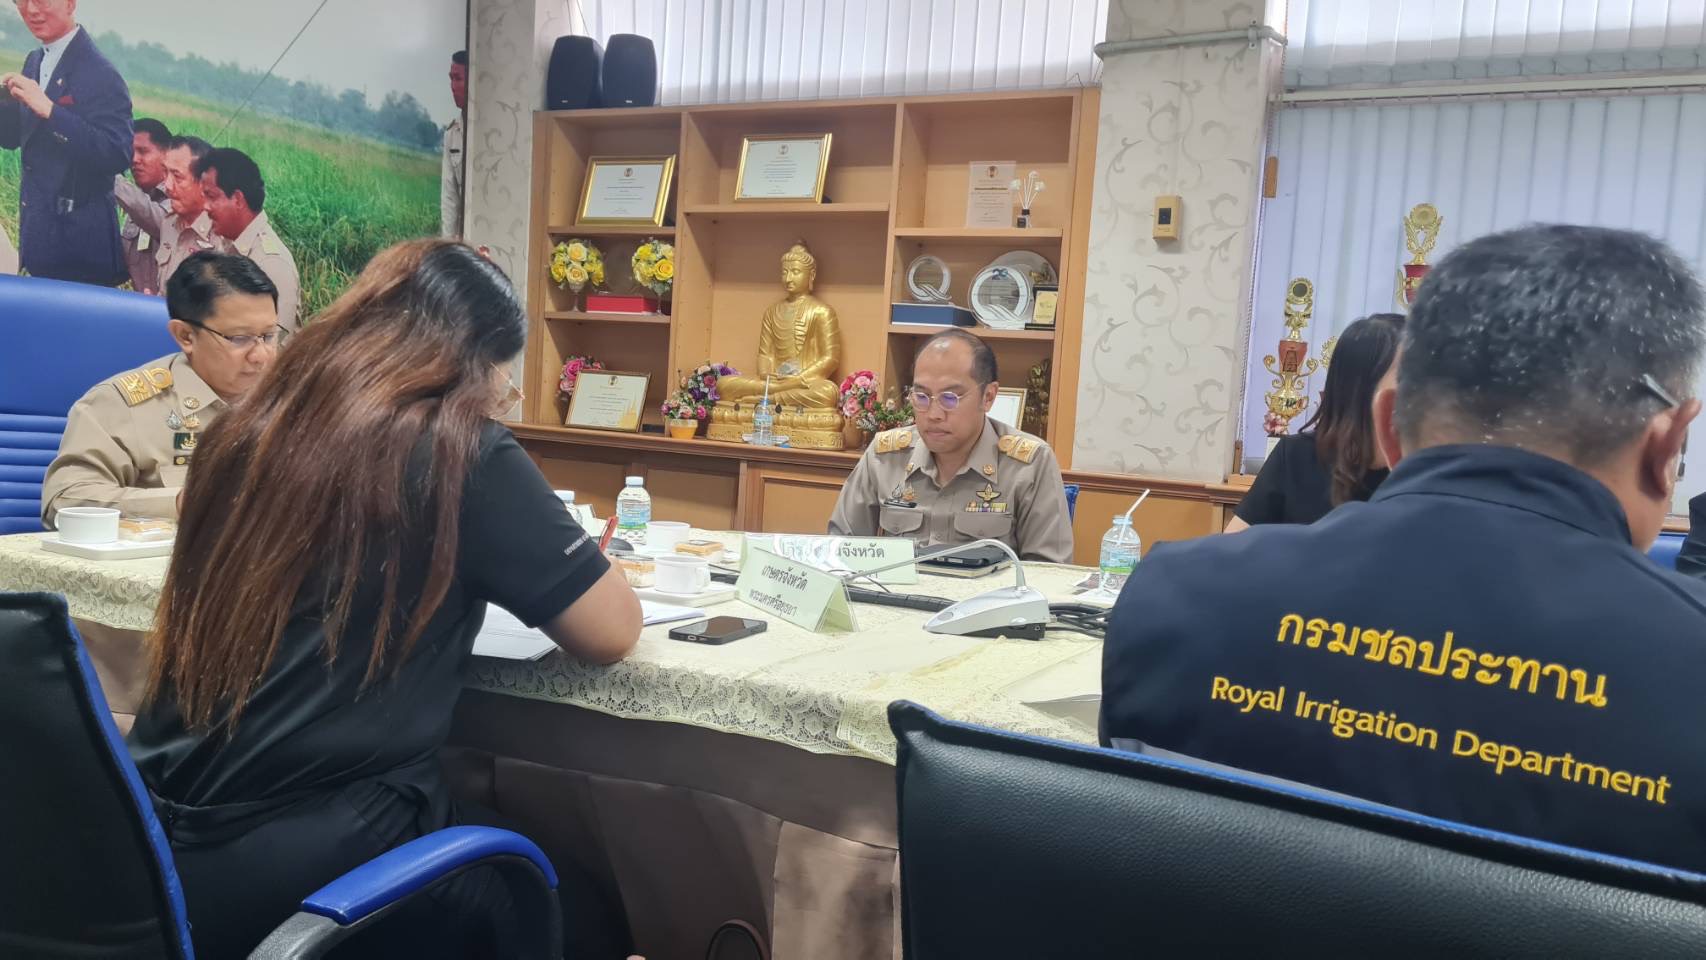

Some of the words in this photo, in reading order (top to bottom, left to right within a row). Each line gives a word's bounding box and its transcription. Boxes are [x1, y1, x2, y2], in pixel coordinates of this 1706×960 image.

[1277, 613, 1608, 708] กรมชลประทาน
[1211, 677, 1286, 713] Royal
[1296, 692, 1438, 750] Irrigation
[1453, 730, 1671, 804] Department
